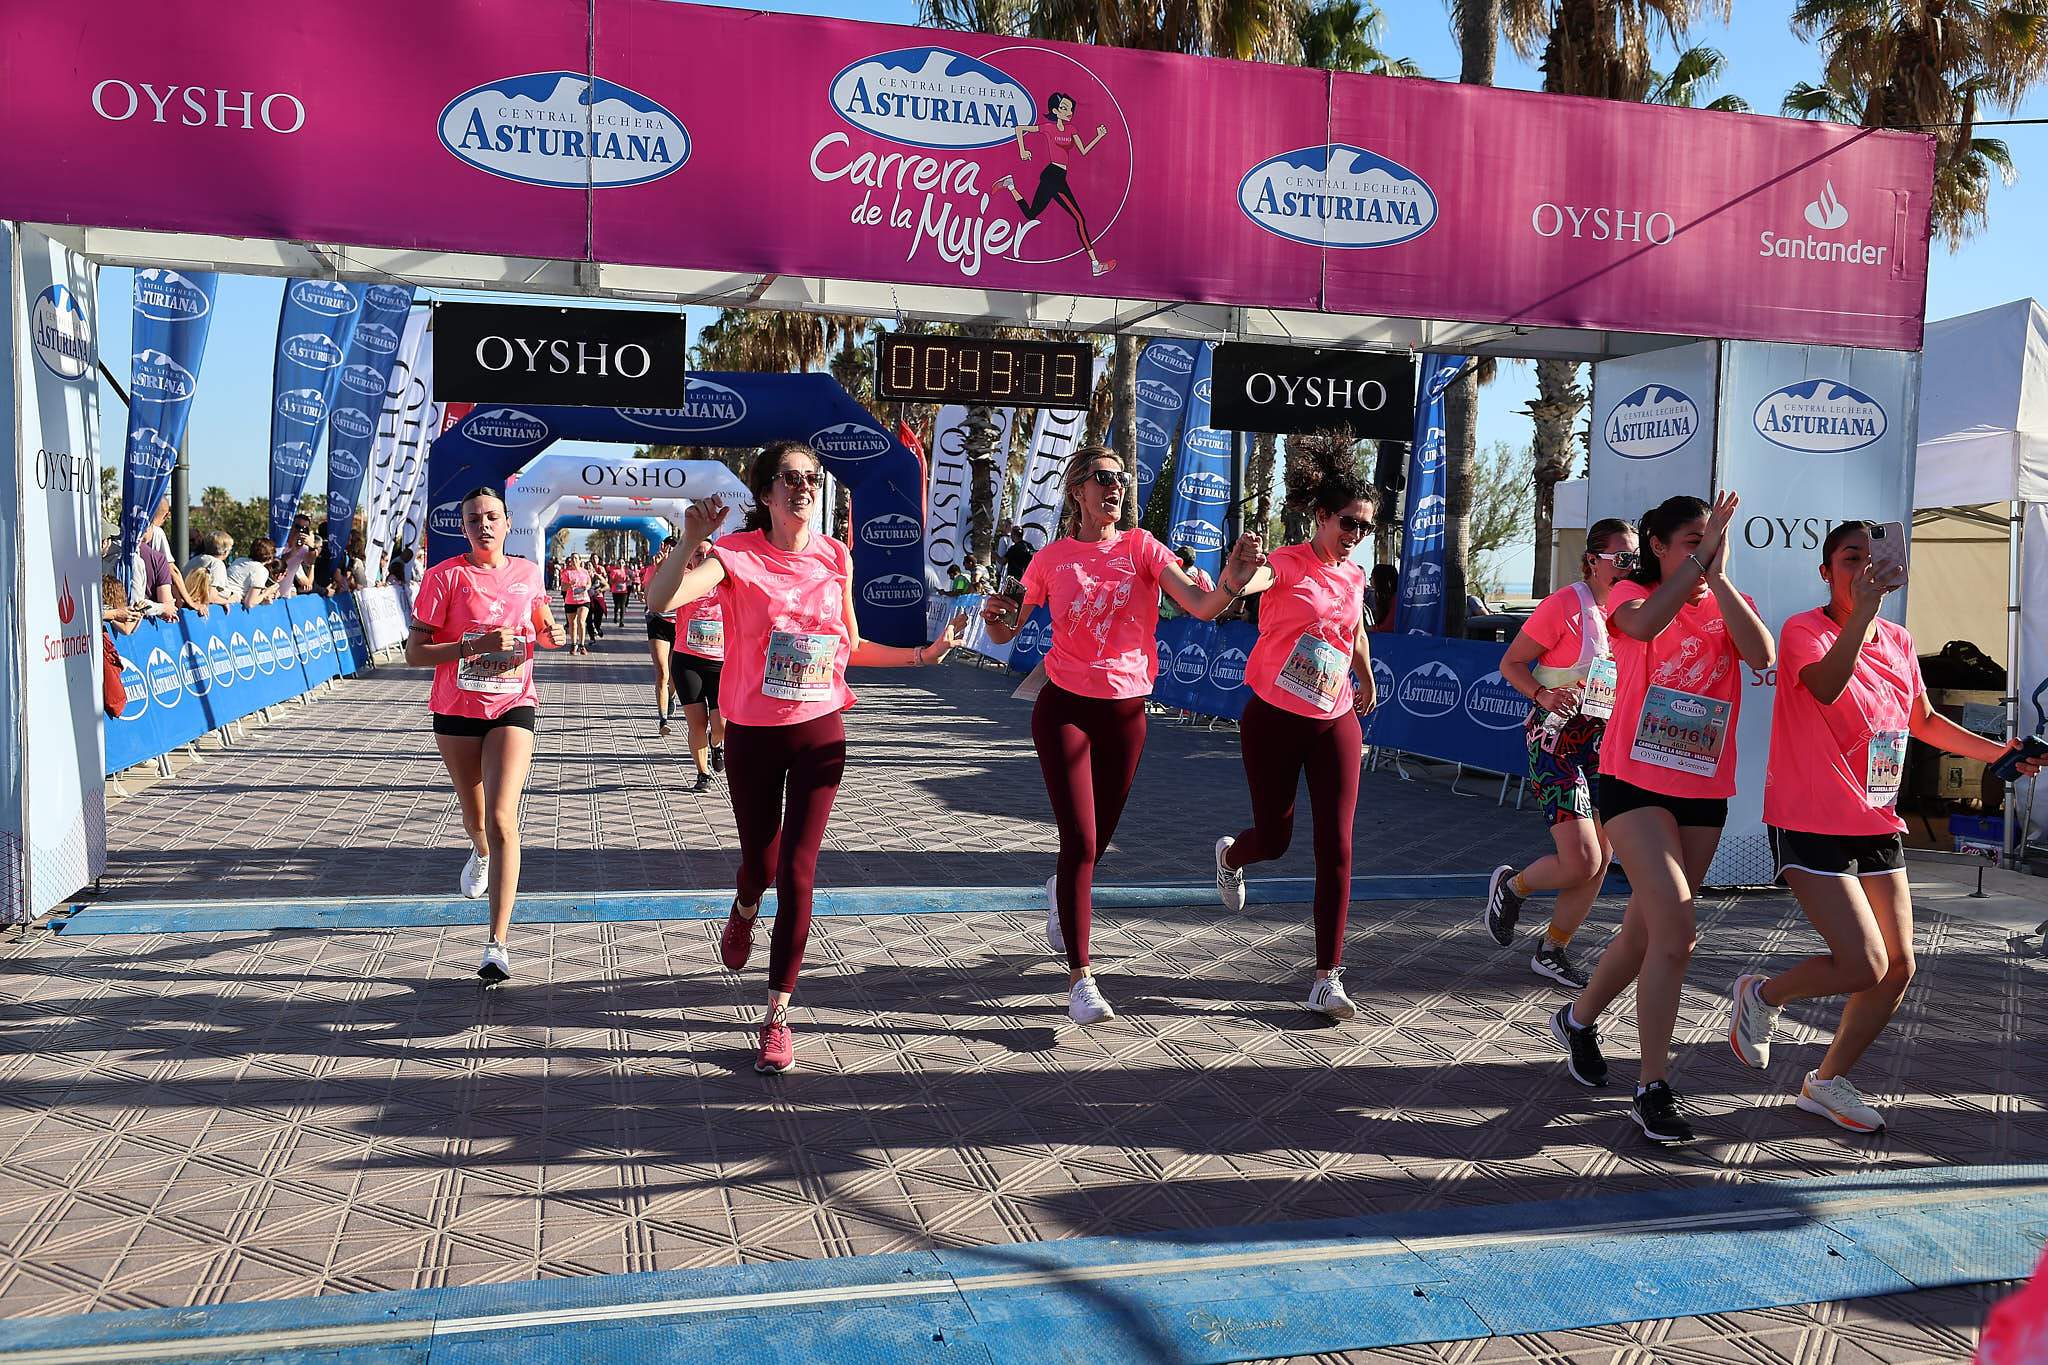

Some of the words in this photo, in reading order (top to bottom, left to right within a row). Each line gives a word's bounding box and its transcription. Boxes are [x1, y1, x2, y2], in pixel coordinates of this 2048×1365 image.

[845, 76, 1019, 129] ASTURIANA
[879, 77, 943, 92] CENTRAL
[950, 84, 1015, 99] LECHERA
[91, 79, 306, 134] OYSHO
[498, 107, 577, 124] CENTRAL
[457, 106, 672, 164] ASTURIANA
[809, 131, 980, 197] Carrera
[1253, 176, 1422, 225] ASTURIANA
[1285, 176, 1348, 190] CENTRAL
[1354, 182, 1417, 196] LECHERA
[851, 190, 883, 228] de
[891, 190, 913, 230] la
[906, 190, 1041, 277] Mujer
[1532, 203, 1677, 246] OYSHO
[1759, 230, 1887, 267] Santander
[36, 309, 89, 363] ASTURIANA
[475, 335, 652, 379] OYSHO
[891, 344, 1077, 397] 00:43:13
[1245, 372, 1387, 413] OYSHO
[1784, 403, 1826, 413] CENTRAL
[1830, 405, 1873, 415] LECHERA
[467, 421, 541, 439] ASTURIANA
[1610, 416, 1691, 443] ASTURIANA
[1762, 404, 1876, 436] ASTURIANA
[816, 437, 885, 451] ASTURIANA
[36, 449, 93, 495] OYSHO
[581, 464, 687, 488] OYSHO
[517, 486, 550, 495] OYSHO
[928, 427, 967, 567] OYSHO
[866, 526, 918, 540] ASTURIANA
[44, 629, 90, 663] Santander
[792, 661, 816, 675] 016
[1401, 680, 1455, 706] ASTURIANA
[1468, 687, 1529, 718] ASTURIANA
[1667, 725, 1700, 743] 016
